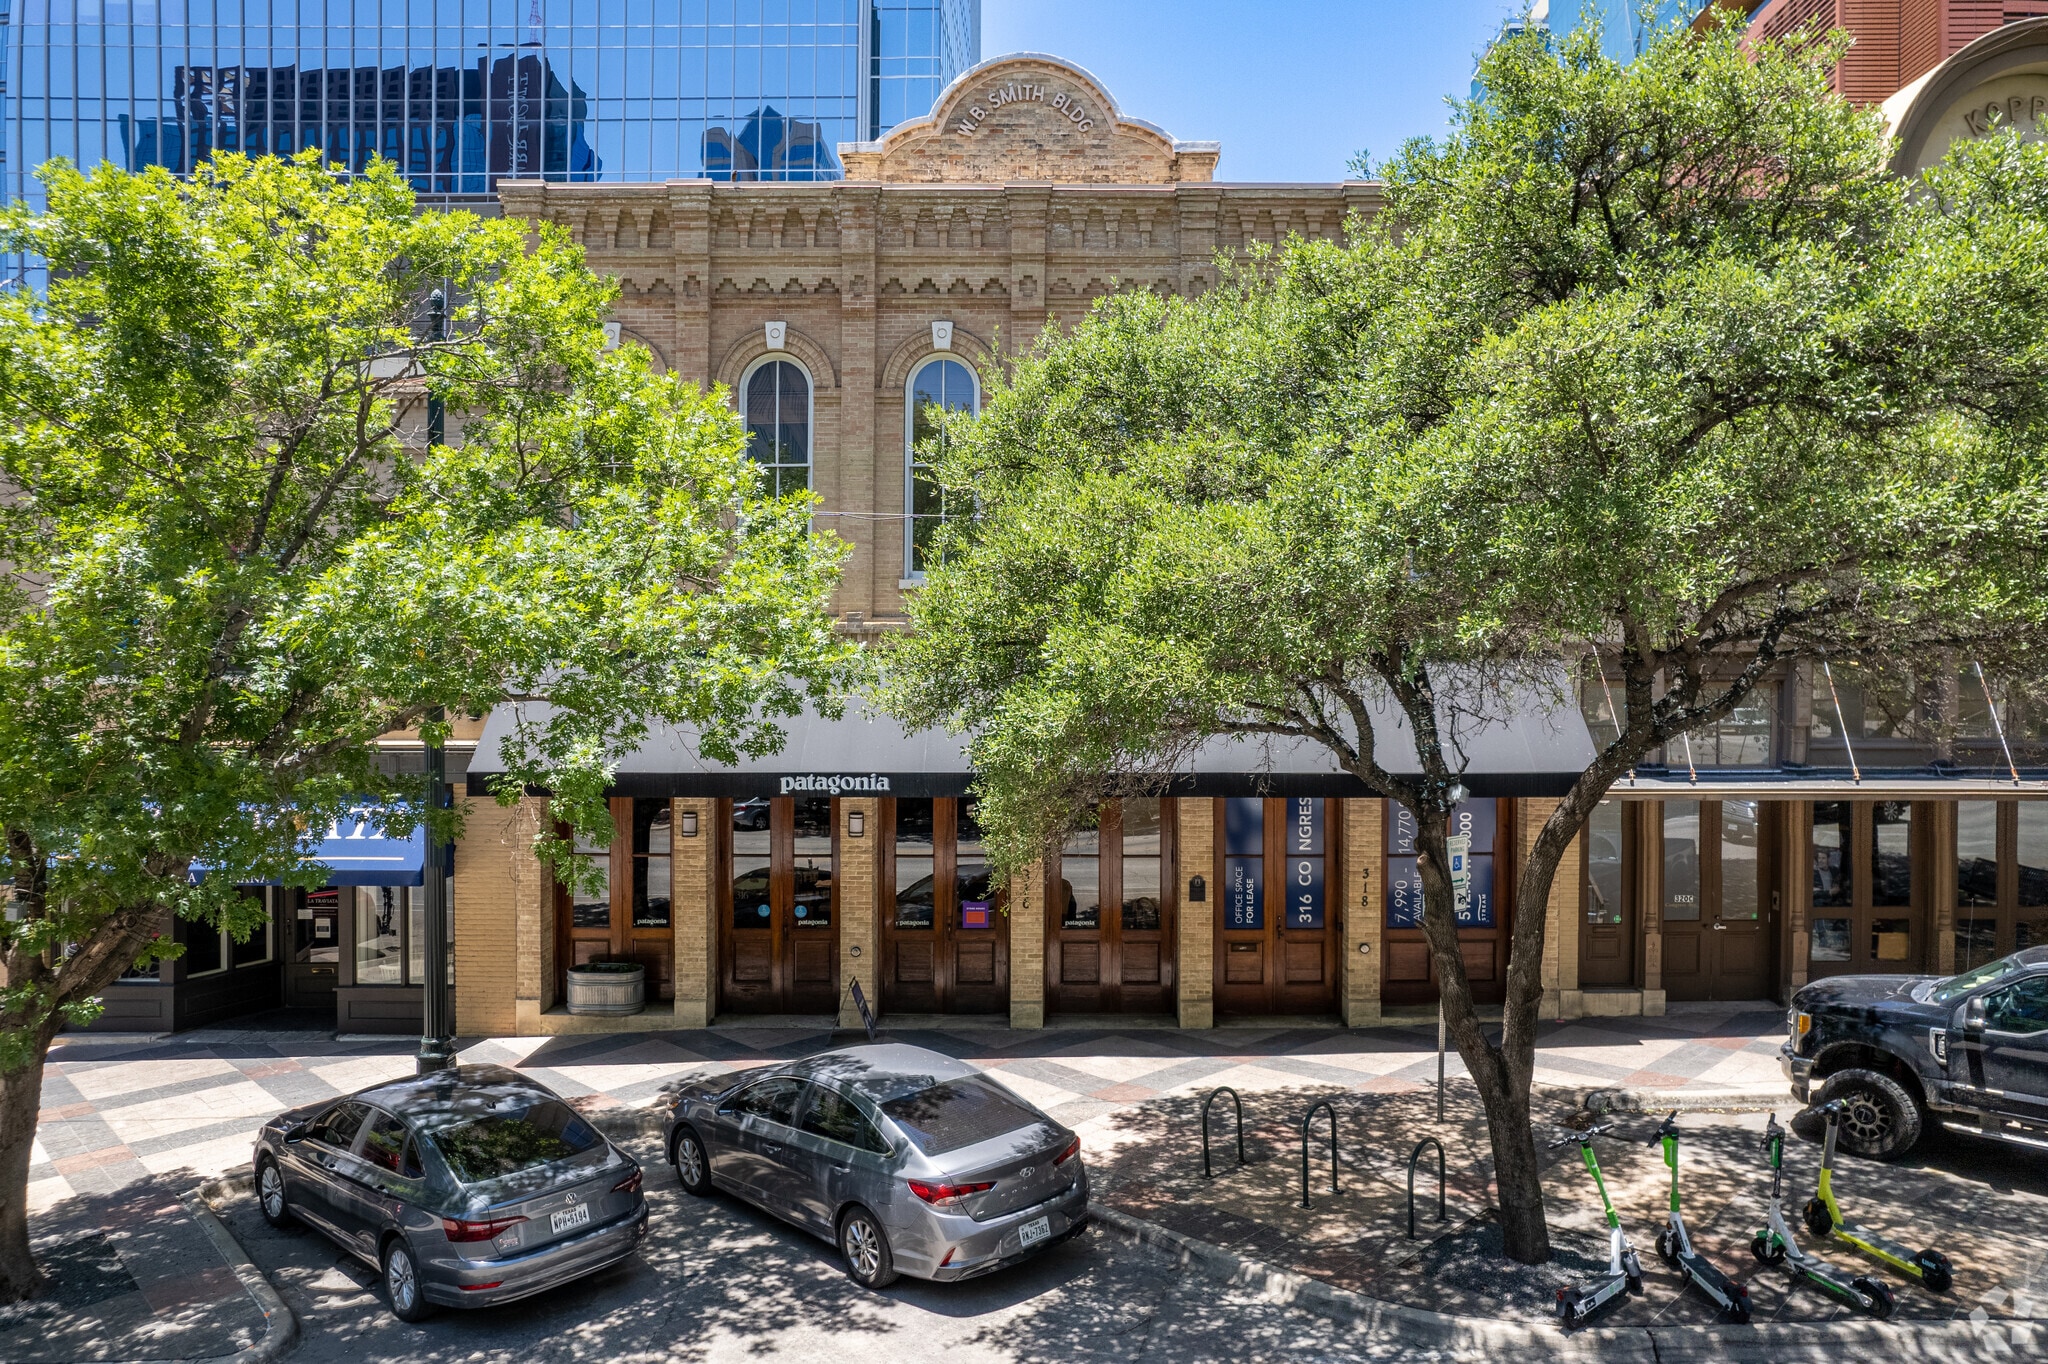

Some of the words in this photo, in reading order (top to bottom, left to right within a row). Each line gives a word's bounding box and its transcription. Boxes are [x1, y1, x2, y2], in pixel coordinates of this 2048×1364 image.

[957, 106, 989, 137] W.B.
[988, 83, 1045, 109] SMITH
[1051, 92, 1094, 133] BLDG
[779, 773, 890, 795] patagonia
[1398, 810, 1413, 854] 14,770
[1235, 866, 1243, 893] SPACE
[1246, 878, 1254, 904] LEASE
[1361, 868, 1370, 907] 318
[1235, 894, 1243, 924] OFFICE
[1299, 894, 1312, 923] 316
[1394, 880, 1410, 923] 7,990
[1413, 872, 1422, 921] AVAILABLE
[1674, 894, 1694, 902] 320C
[636, 918, 668, 926] patagonia
[797, 919, 829, 927] patagonia
[899, 919, 930, 927] patagonia
[1064, 919, 1096, 927] patagonia
[1246, 906, 1254, 924] FOR
